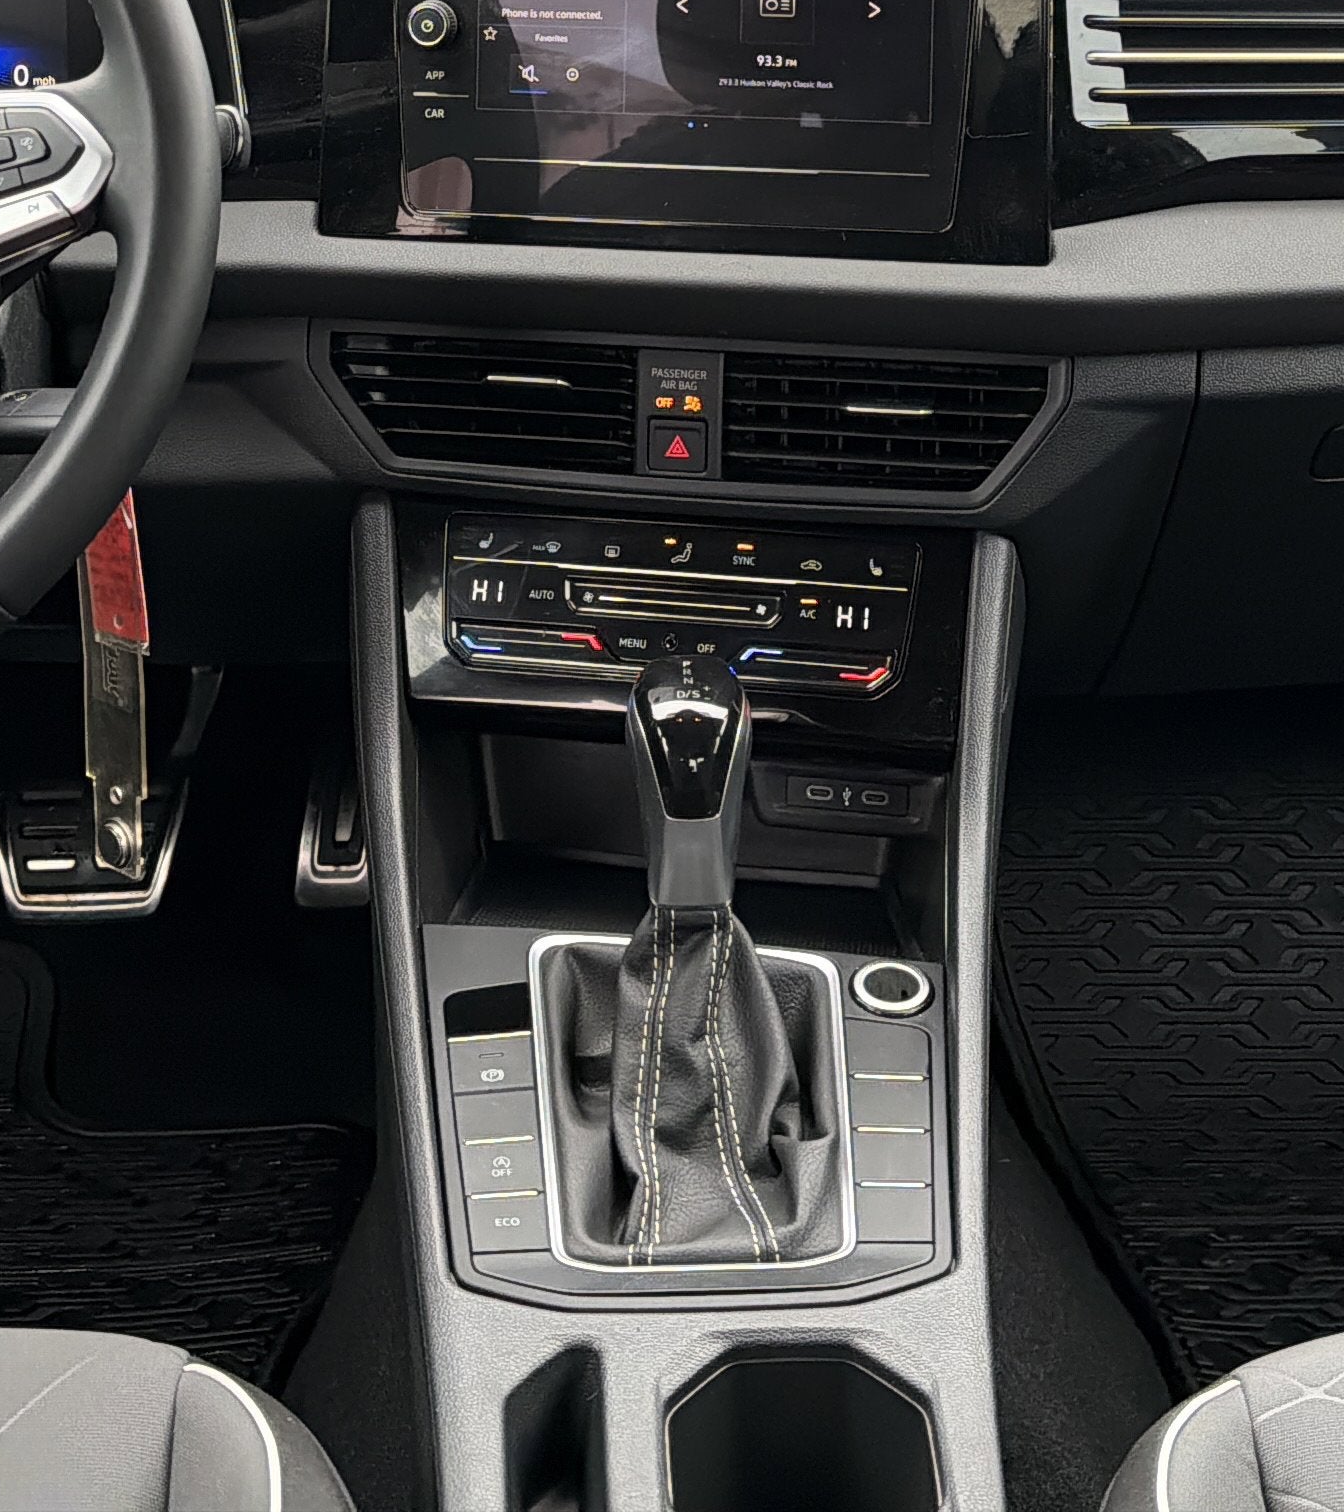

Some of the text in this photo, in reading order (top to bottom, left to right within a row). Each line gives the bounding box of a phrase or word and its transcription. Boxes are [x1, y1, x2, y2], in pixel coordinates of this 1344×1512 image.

[501, 8, 603, 20] Phone is not connected.
[534, 33, 568, 43] Favorites
[756, 54, 798, 67] 93.3 FM
[13, 65, 56, 88] 0 mph
[425, 71, 445, 81] APP
[424, 108, 445, 119] CAR
[651, 367, 707, 380] PASSENGER
[660, 380, 698, 391] AIR BAG
[656, 396, 674, 409] OFF
[732, 555, 756, 566] SYNC
[471, 579, 504, 603] HI
[529, 589, 554, 600] AUTO
[800, 609, 817, 620] A/C
[836, 605, 869, 630] HI
[619, 637, 647, 649] MENU
[697, 643, 716, 654] OFF
[683, 677, 693, 685] N
[676, 690, 701, 699] D/S
[491, 1168, 513, 1178] OFF
[494, 1217, 521, 1227] ECO
